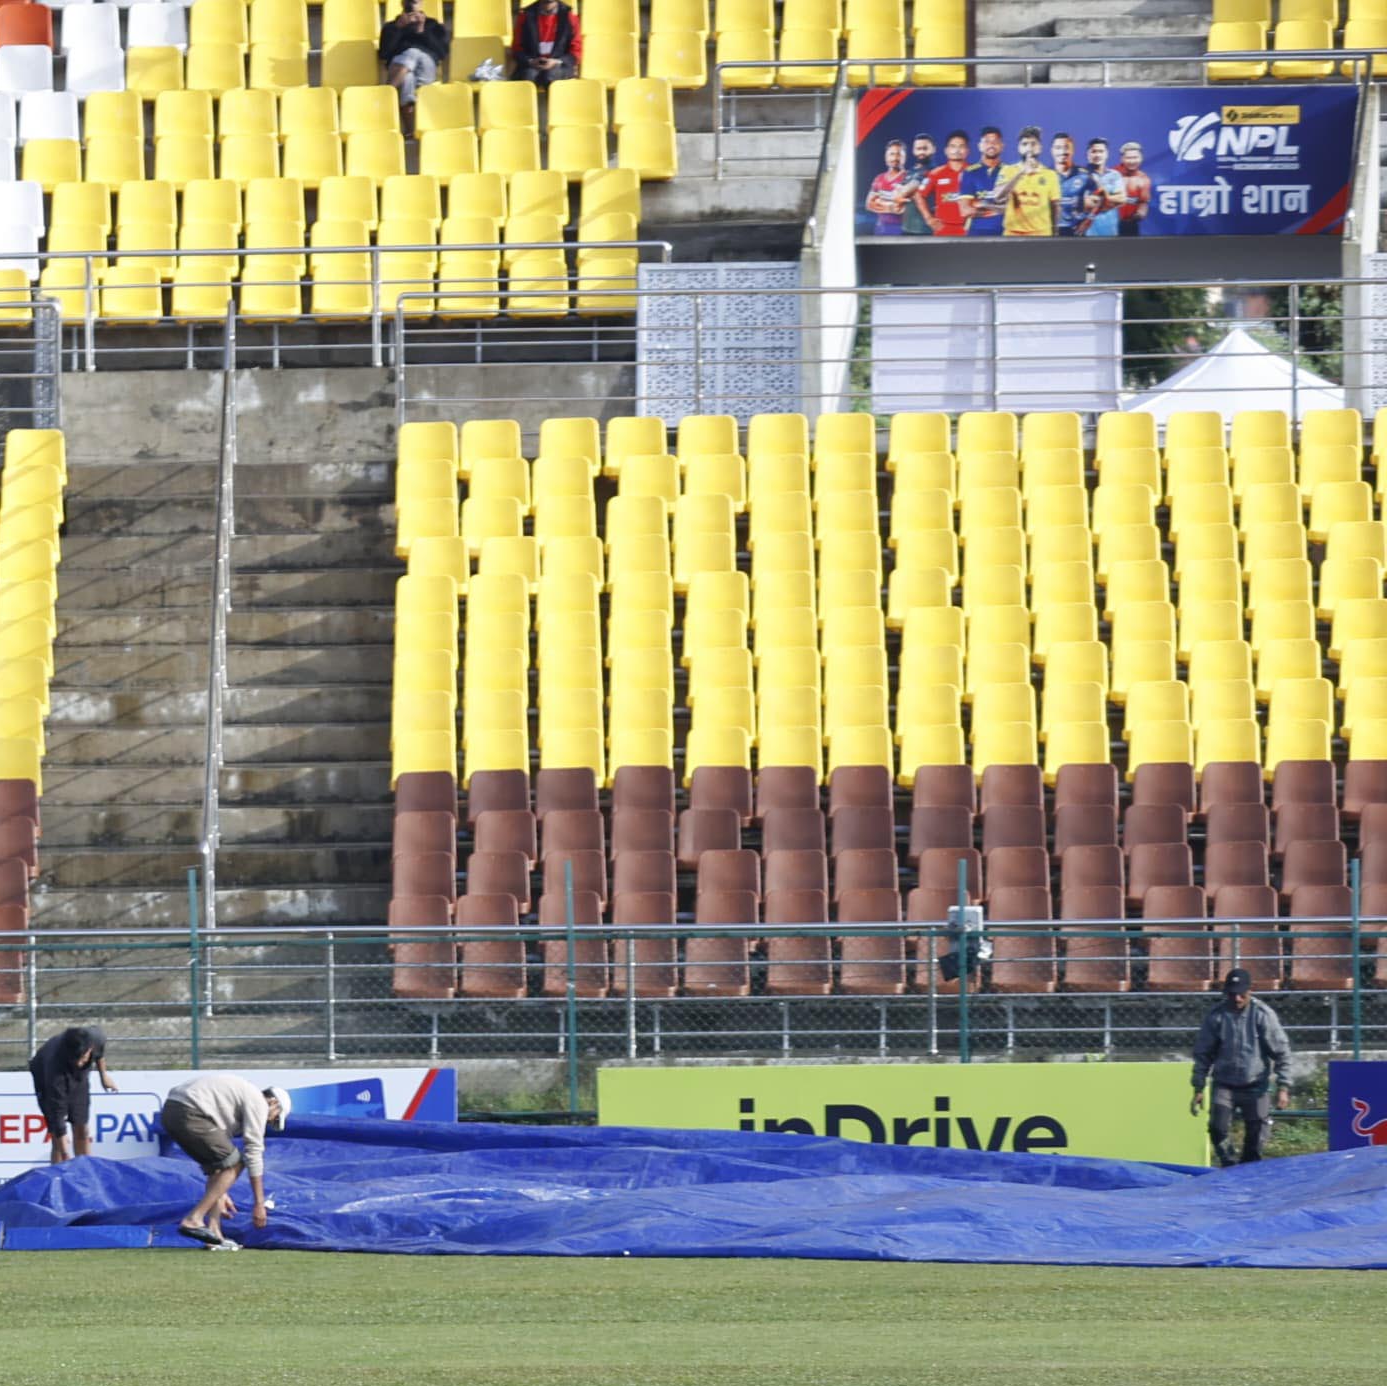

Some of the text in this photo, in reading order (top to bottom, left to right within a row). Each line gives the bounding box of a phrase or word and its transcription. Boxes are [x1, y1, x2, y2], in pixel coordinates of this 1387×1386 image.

[1216, 126, 1300, 156] NPL
[1155, 176, 1312, 217] हाम्रो शान
